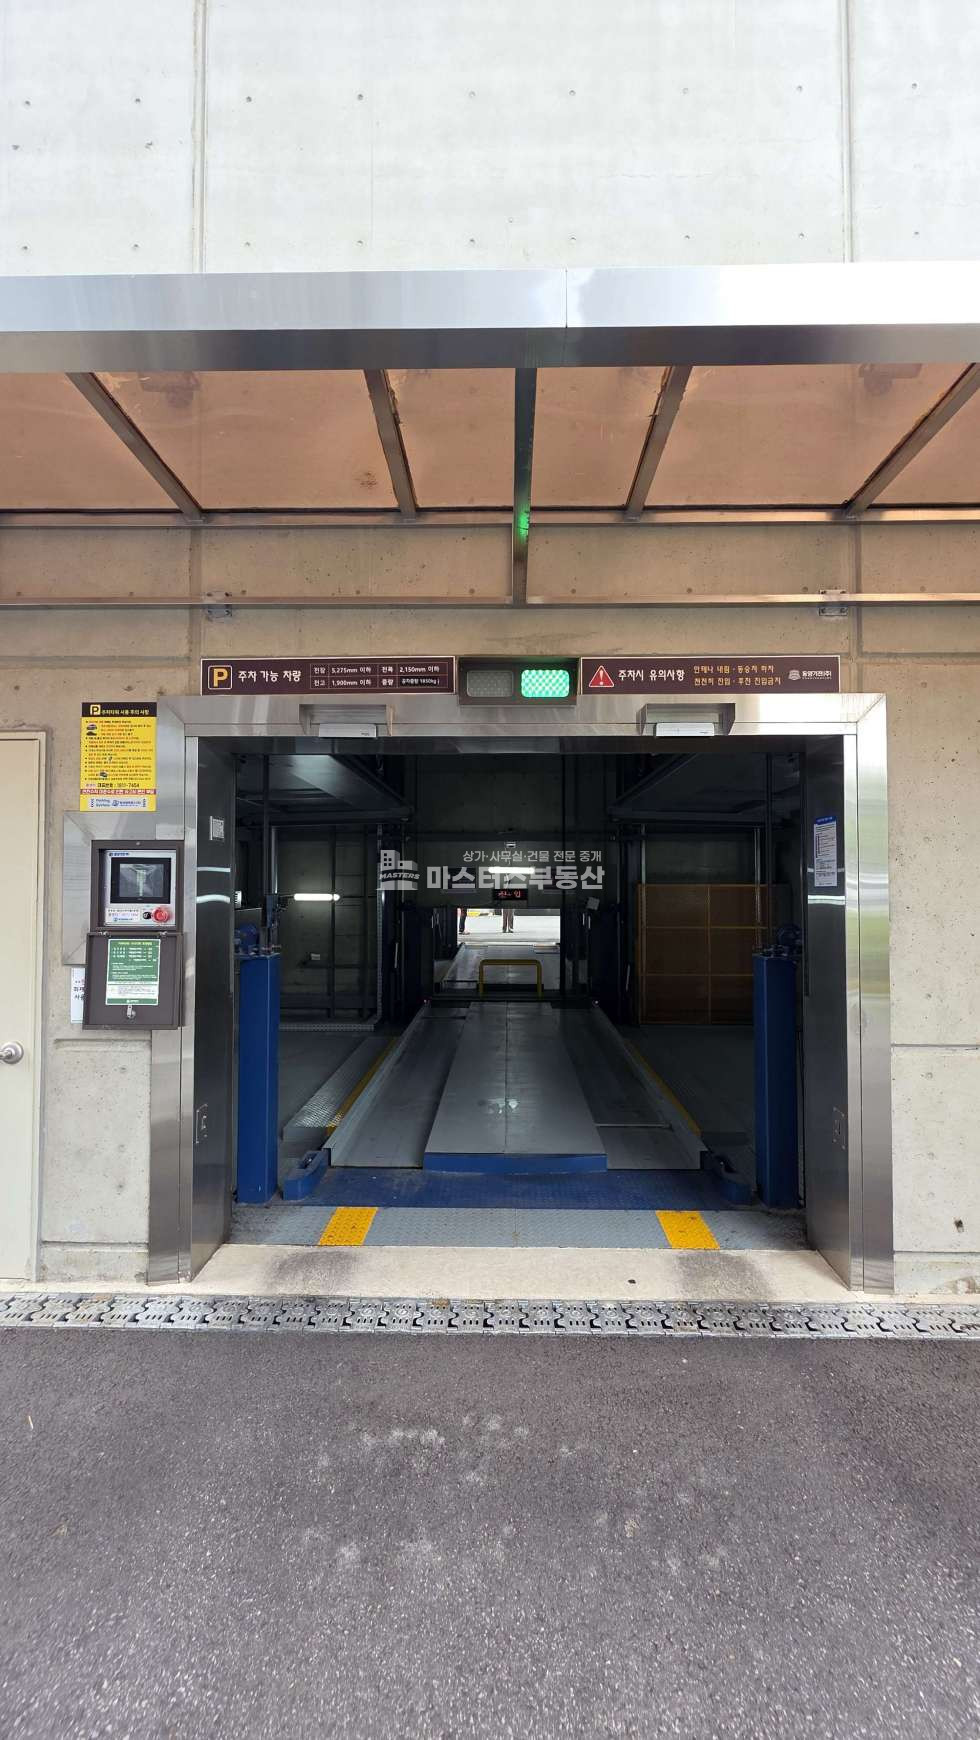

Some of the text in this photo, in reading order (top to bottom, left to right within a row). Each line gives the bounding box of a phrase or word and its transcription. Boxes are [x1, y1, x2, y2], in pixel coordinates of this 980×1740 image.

[618, 669, 685, 682] 주차시 유의사항
[693, 665, 714, 674] 안테나
[213, 668, 228, 687] P
[238, 670, 302, 682] 주차 가능 차량
